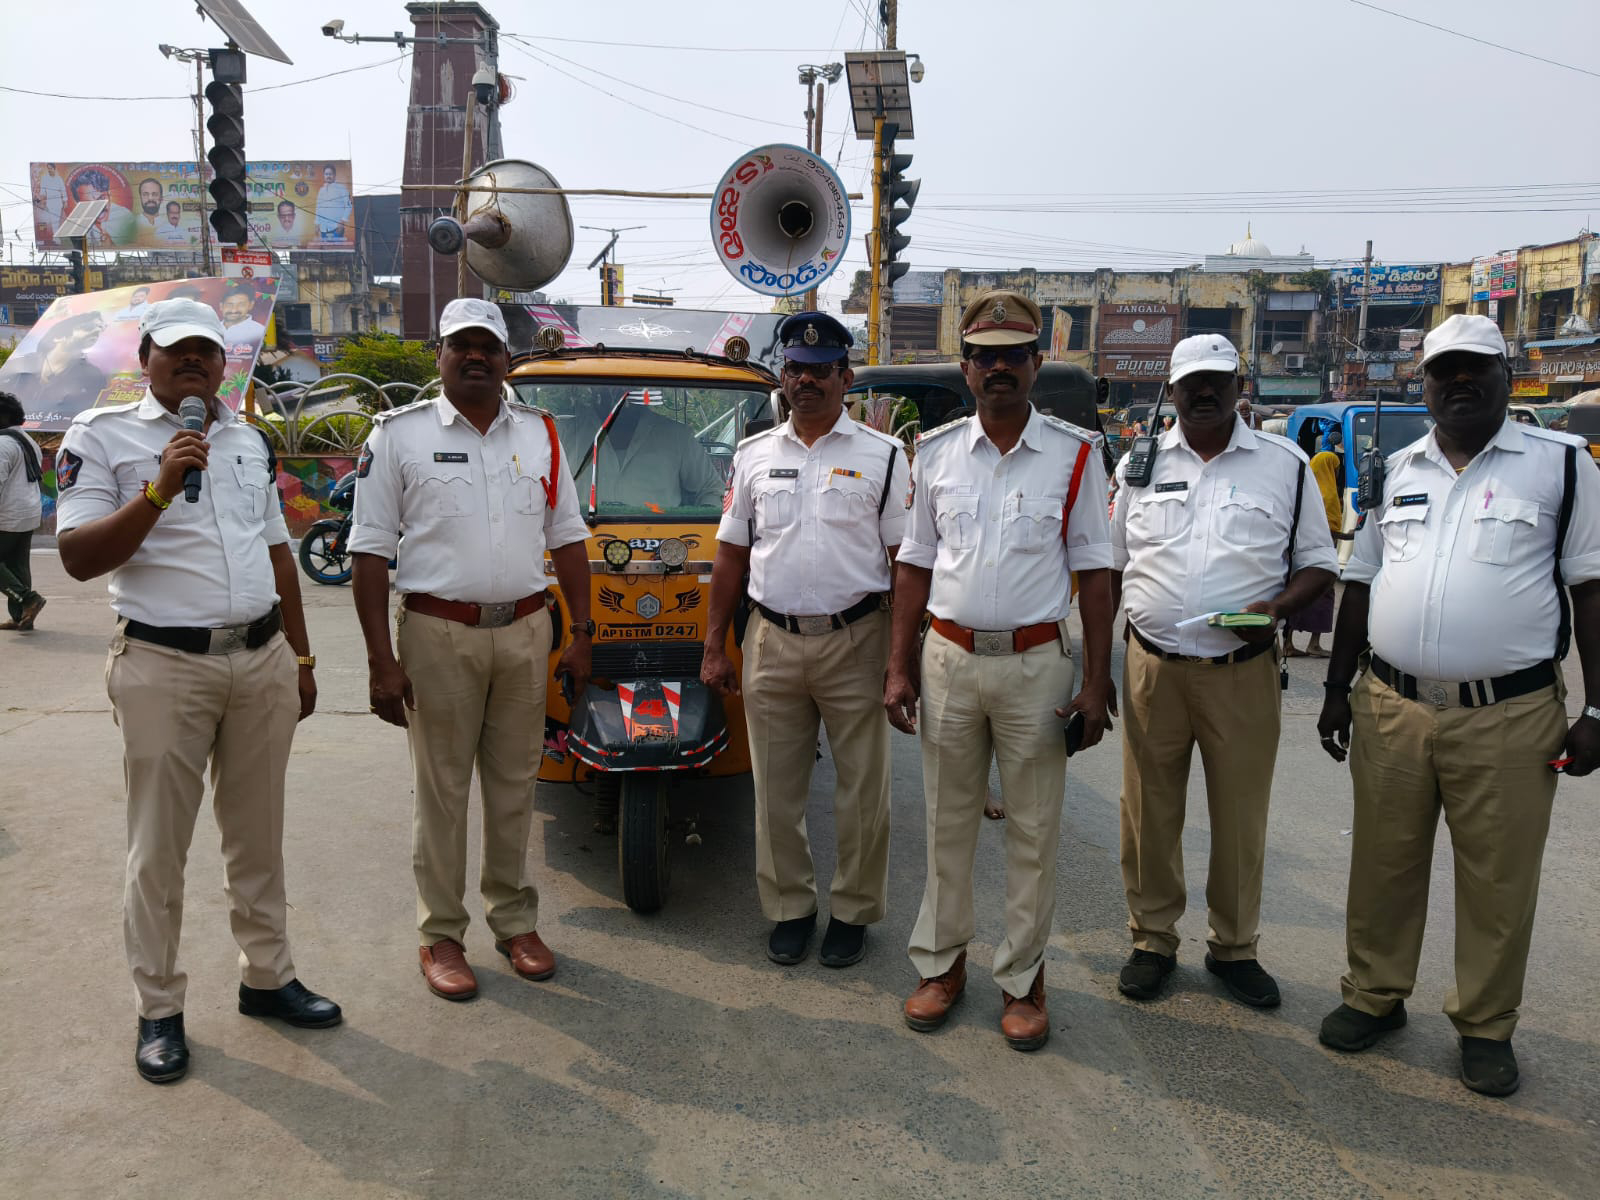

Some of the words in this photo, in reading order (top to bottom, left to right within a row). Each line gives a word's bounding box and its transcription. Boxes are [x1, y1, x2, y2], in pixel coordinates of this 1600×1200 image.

[1116, 305, 1167, 313] JANGALA
[655, 625, 695, 636] 0247
[633, 699, 667, 718] 4
